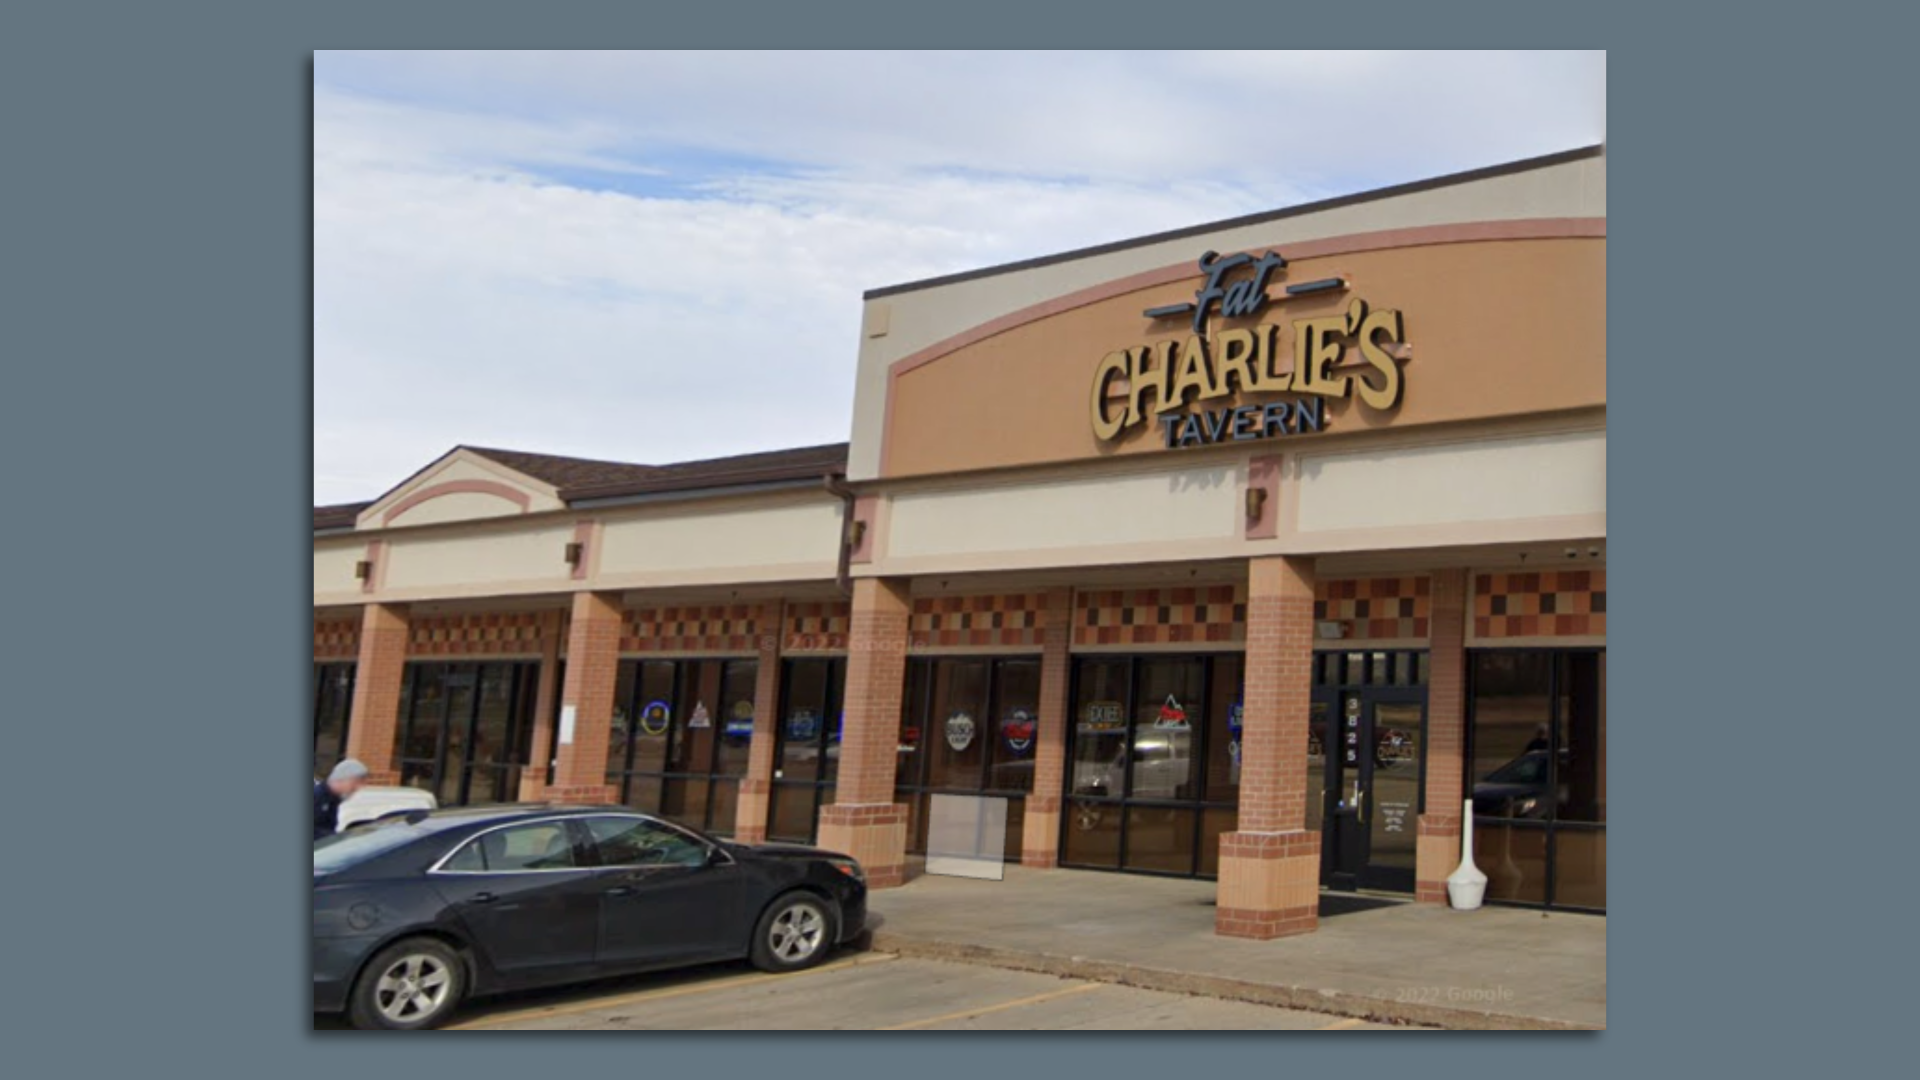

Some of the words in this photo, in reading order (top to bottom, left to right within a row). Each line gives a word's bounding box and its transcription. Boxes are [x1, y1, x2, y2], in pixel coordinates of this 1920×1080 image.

[1194, 250, 1287, 334] Fat
[1090, 298, 1407, 442] CHARLIE'S
[1160, 397, 1326, 448] TAVERN
